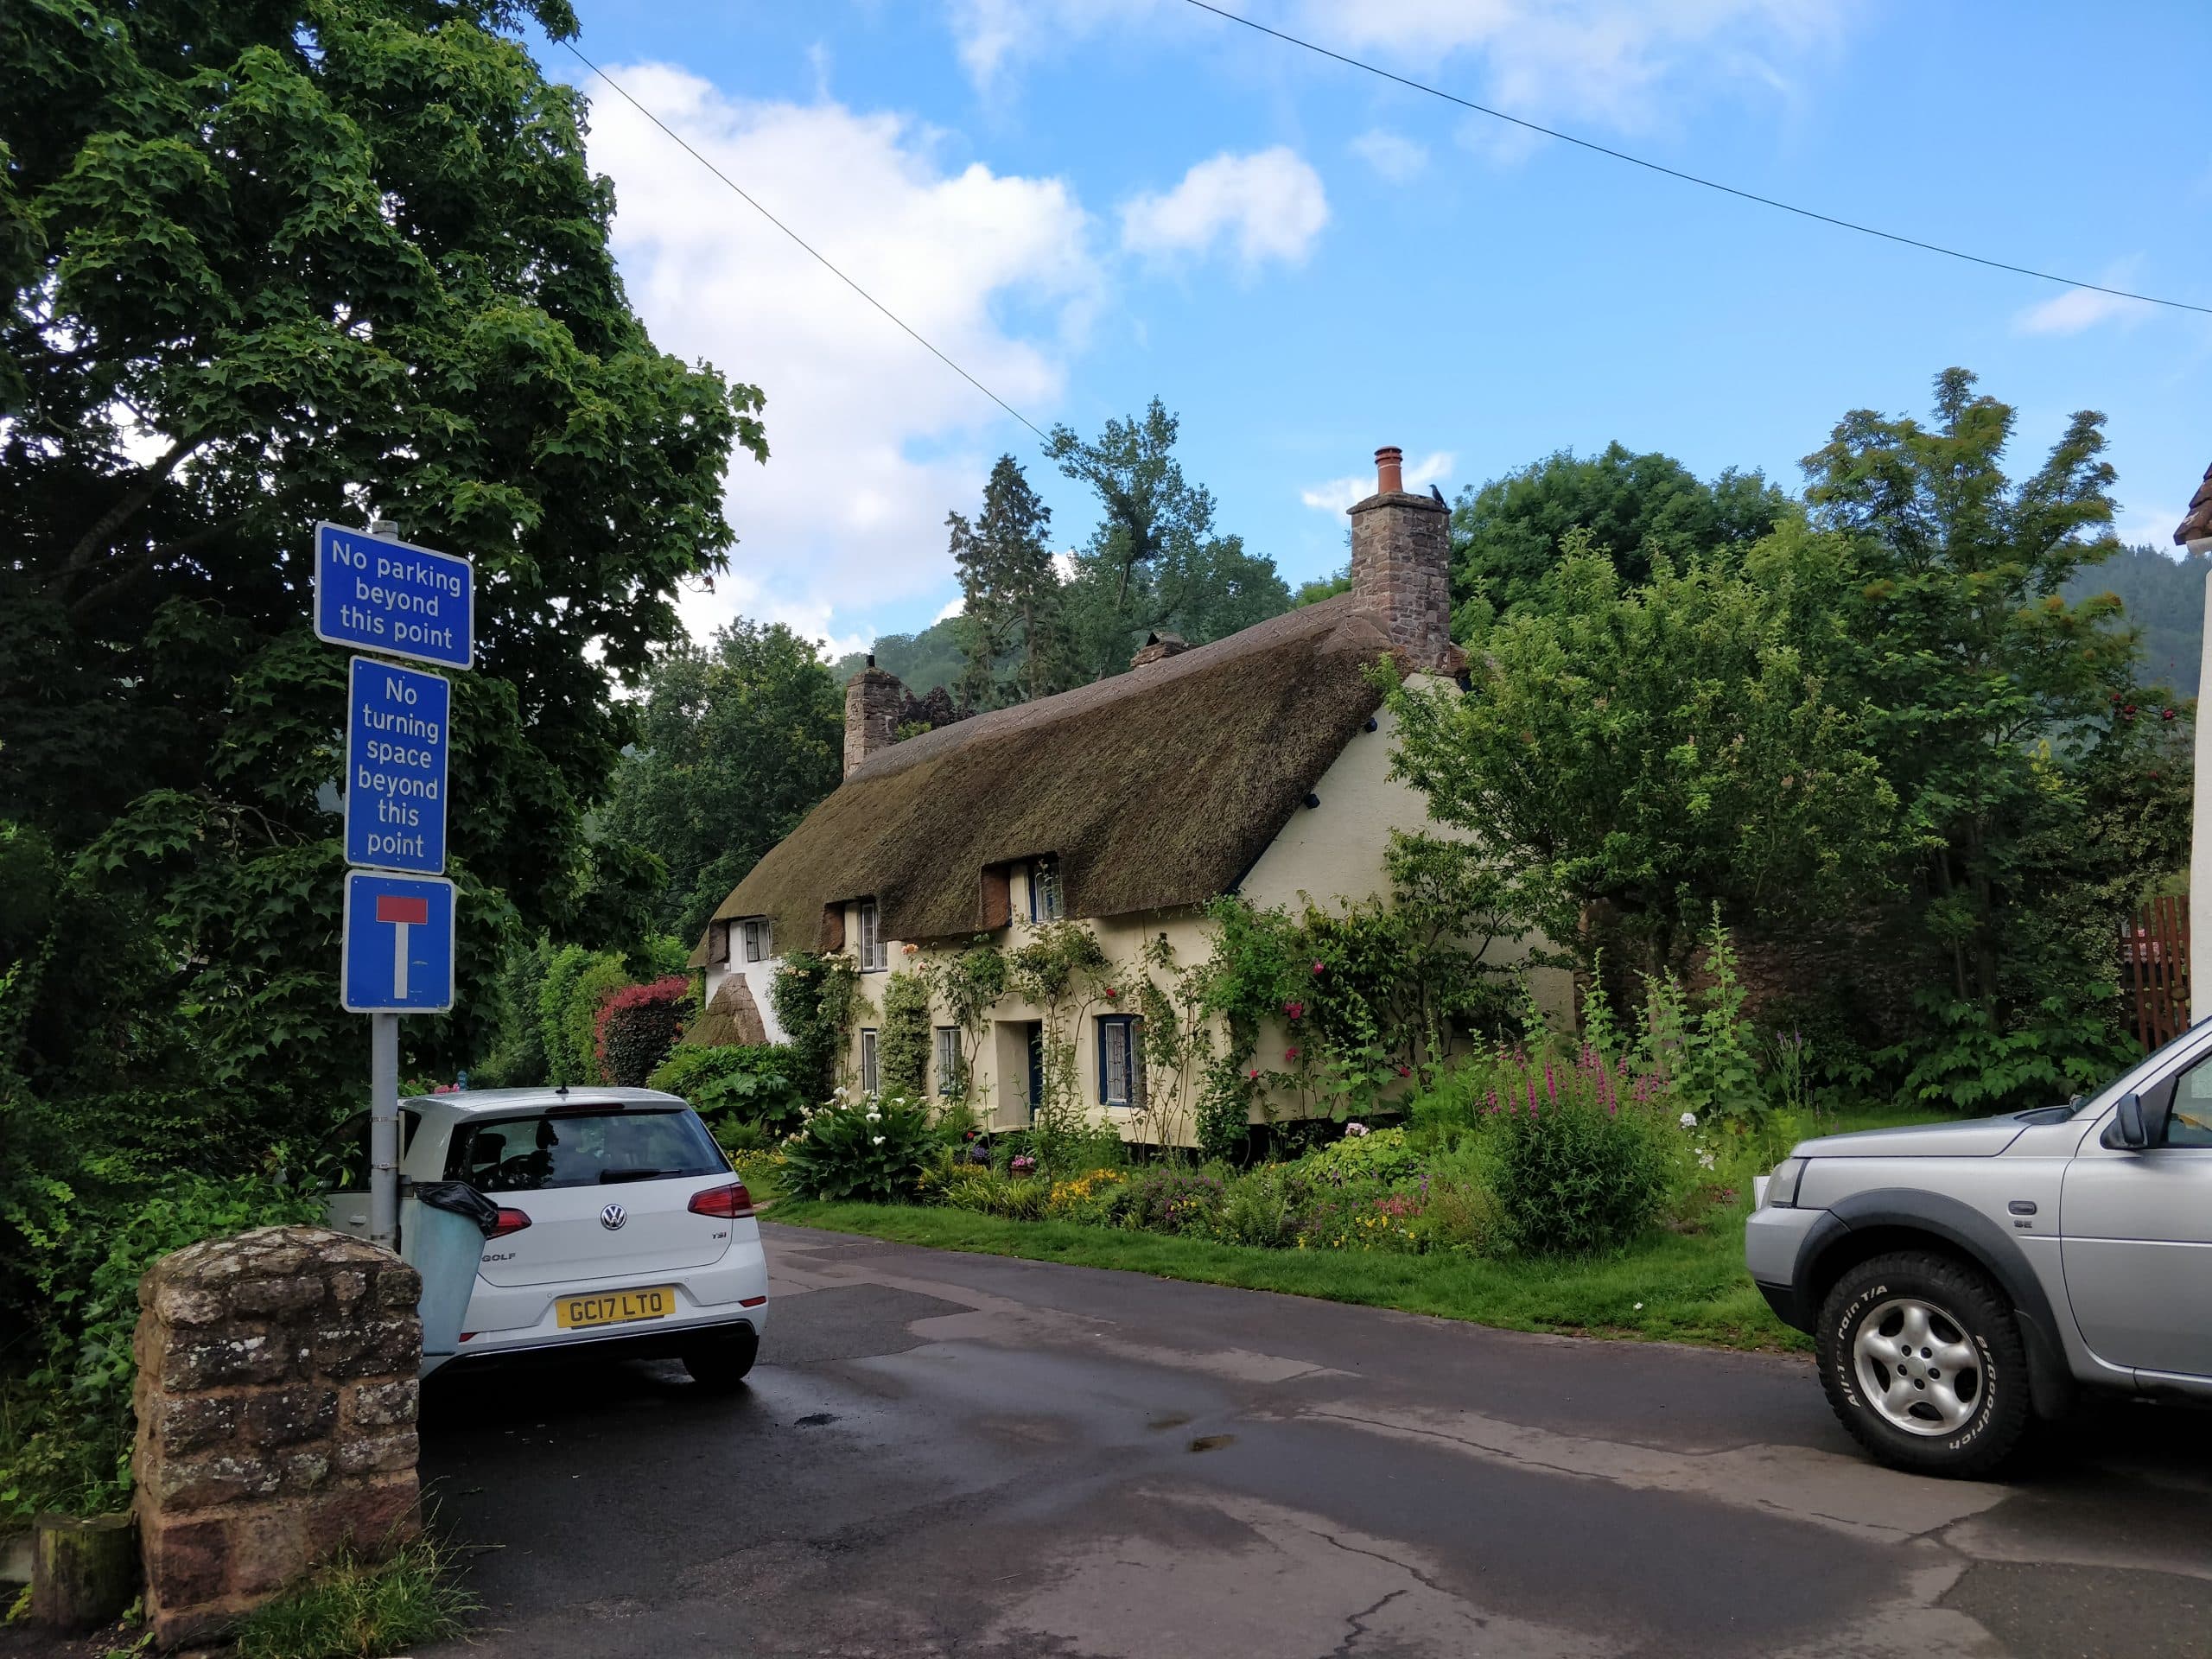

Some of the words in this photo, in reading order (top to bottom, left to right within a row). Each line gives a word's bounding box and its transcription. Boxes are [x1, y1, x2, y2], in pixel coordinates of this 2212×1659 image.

[332, 540, 367, 569] No
[377, 557, 461, 598] parking
[355, 576, 439, 617] beyond
[340, 604, 385, 634] this
[394, 622, 453, 649] point
[385, 677, 417, 705] No
[363, 703, 439, 745] turning
[366, 740, 432, 768] space
[359, 765, 438, 800] beyond
[378, 798, 419, 827] this
[367, 832, 424, 858] point
[481, 1252, 516, 1262] GOLF
[569, 1298, 616, 1322] GC17
[622, 1293, 662, 1316] LTO
[1860, 1285, 1887, 1302] T/A
[1949, 1335, 1996, 1450] BFGoodrich
